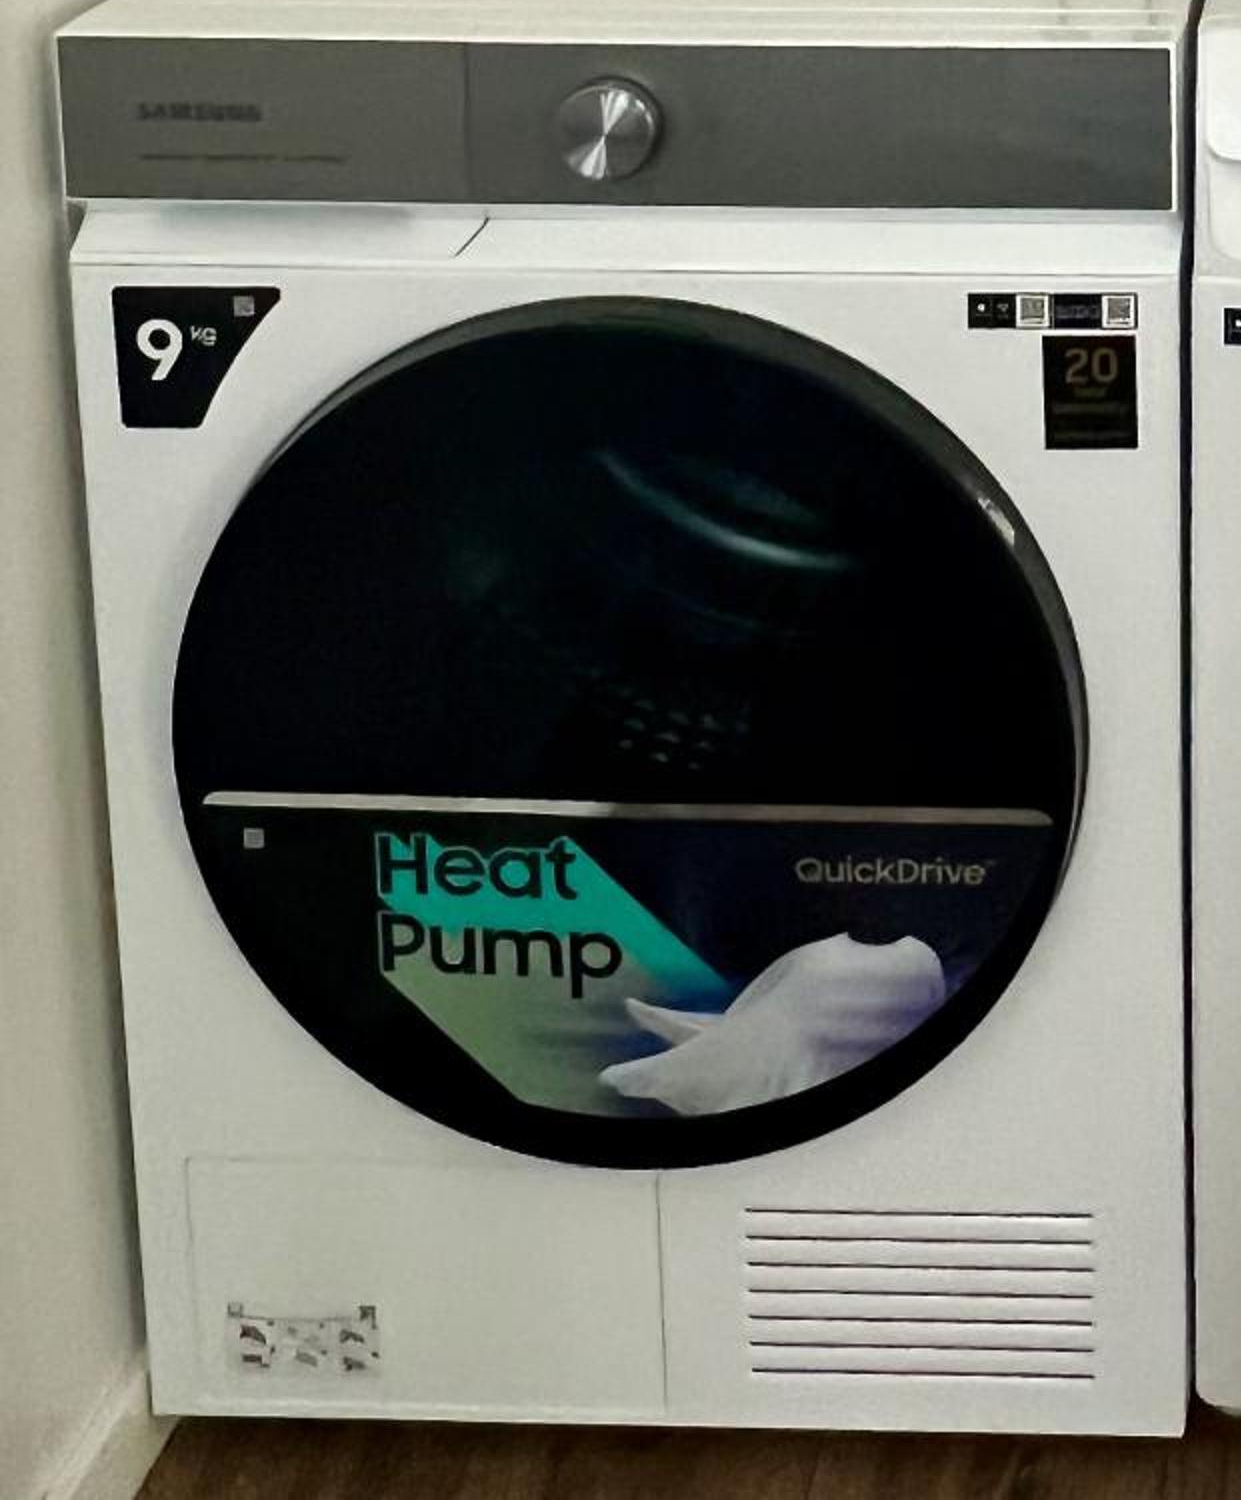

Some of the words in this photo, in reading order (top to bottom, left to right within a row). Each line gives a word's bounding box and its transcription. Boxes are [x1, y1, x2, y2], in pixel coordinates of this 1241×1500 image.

[136, 319, 183, 381] 9
[1064, 347, 1118, 383] 20
[375, 833, 578, 900] Heat
[795, 855, 986, 885] QuickDrive
[377, 910, 623, 999] Pump
